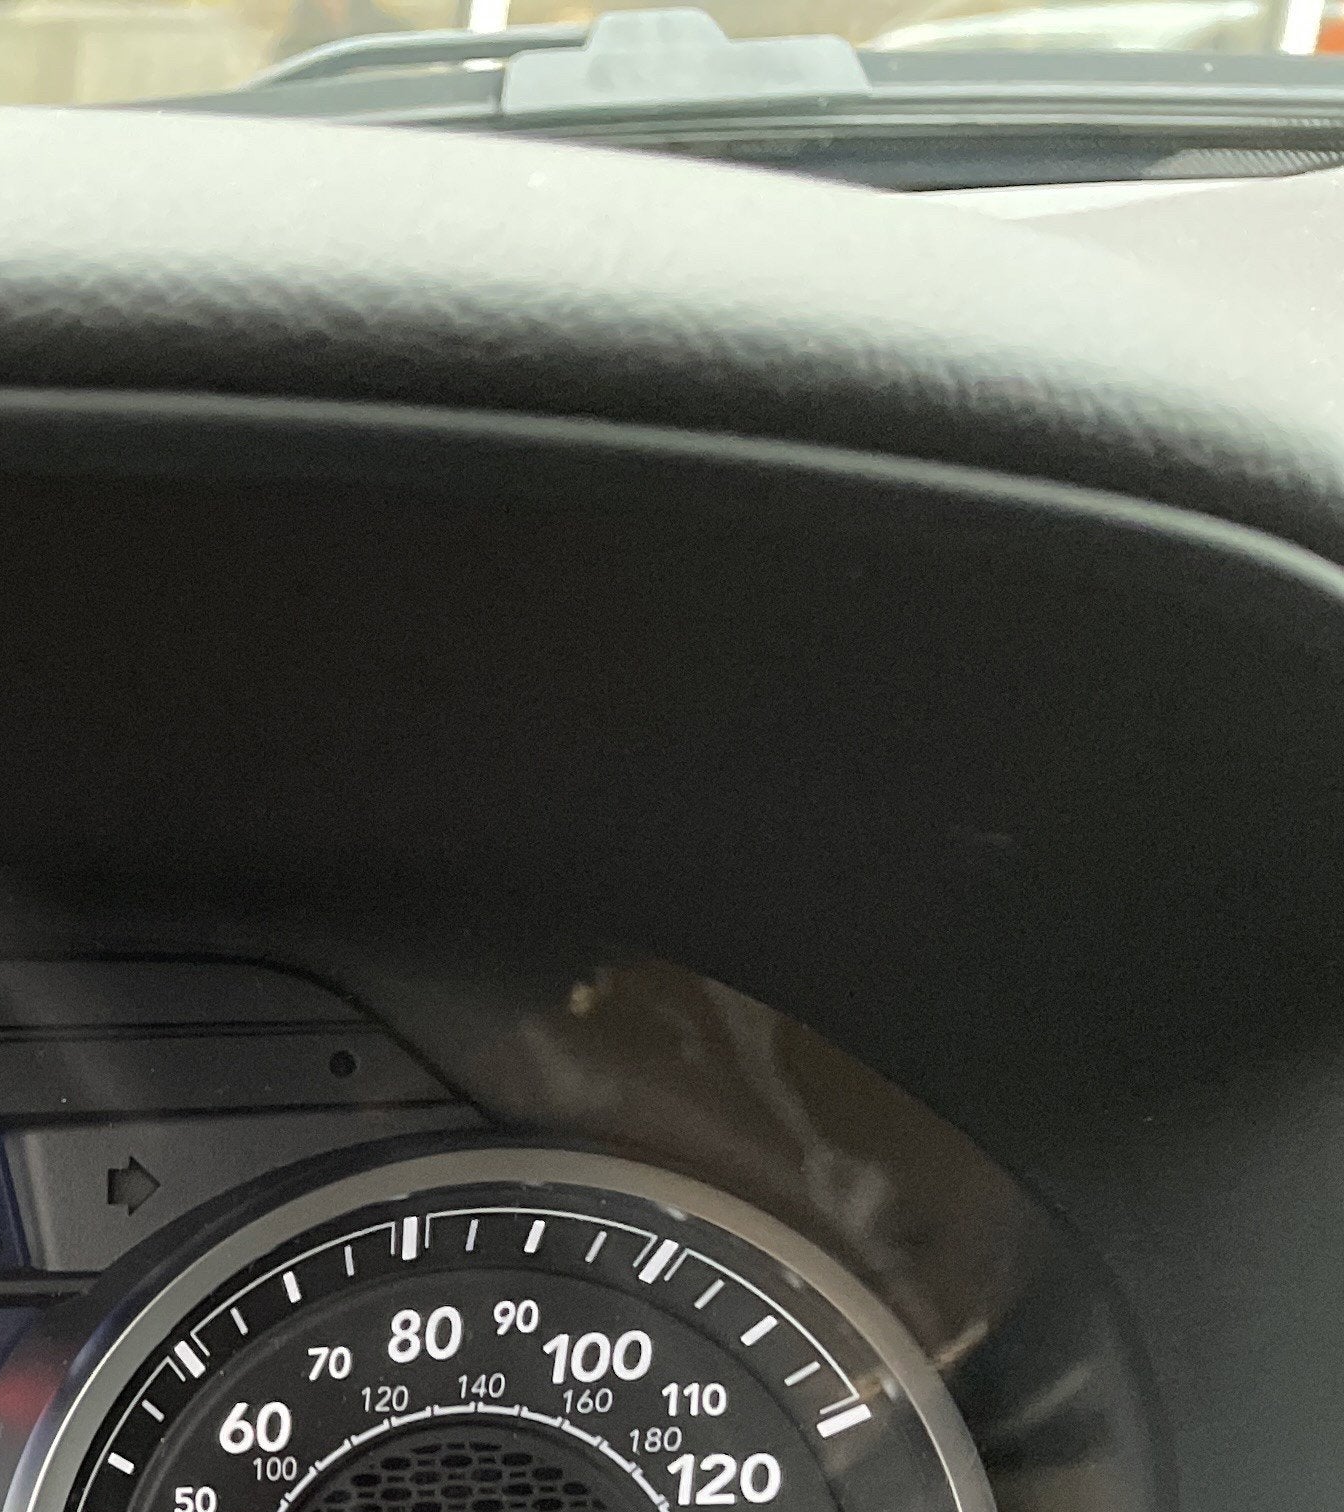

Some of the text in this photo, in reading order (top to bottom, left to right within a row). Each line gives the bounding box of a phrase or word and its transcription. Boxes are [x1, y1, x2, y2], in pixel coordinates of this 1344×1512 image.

[388, 1306, 462, 1362] 80
[494, 1300, 539, 1335] 90
[308, 1346, 352, 1380] 70
[543, 1331, 653, 1384] 100
[362, 1386, 409, 1413] 120
[459, 1373, 506, 1398] 140
[564, 1388, 613, 1413] 160
[662, 1383, 727, 1416] 110
[219, 1402, 291, 1454] 60
[630, 1427, 682, 1453] 180
[254, 1457, 298, 1481] 100
[667, 1453, 781, 1505] 120
